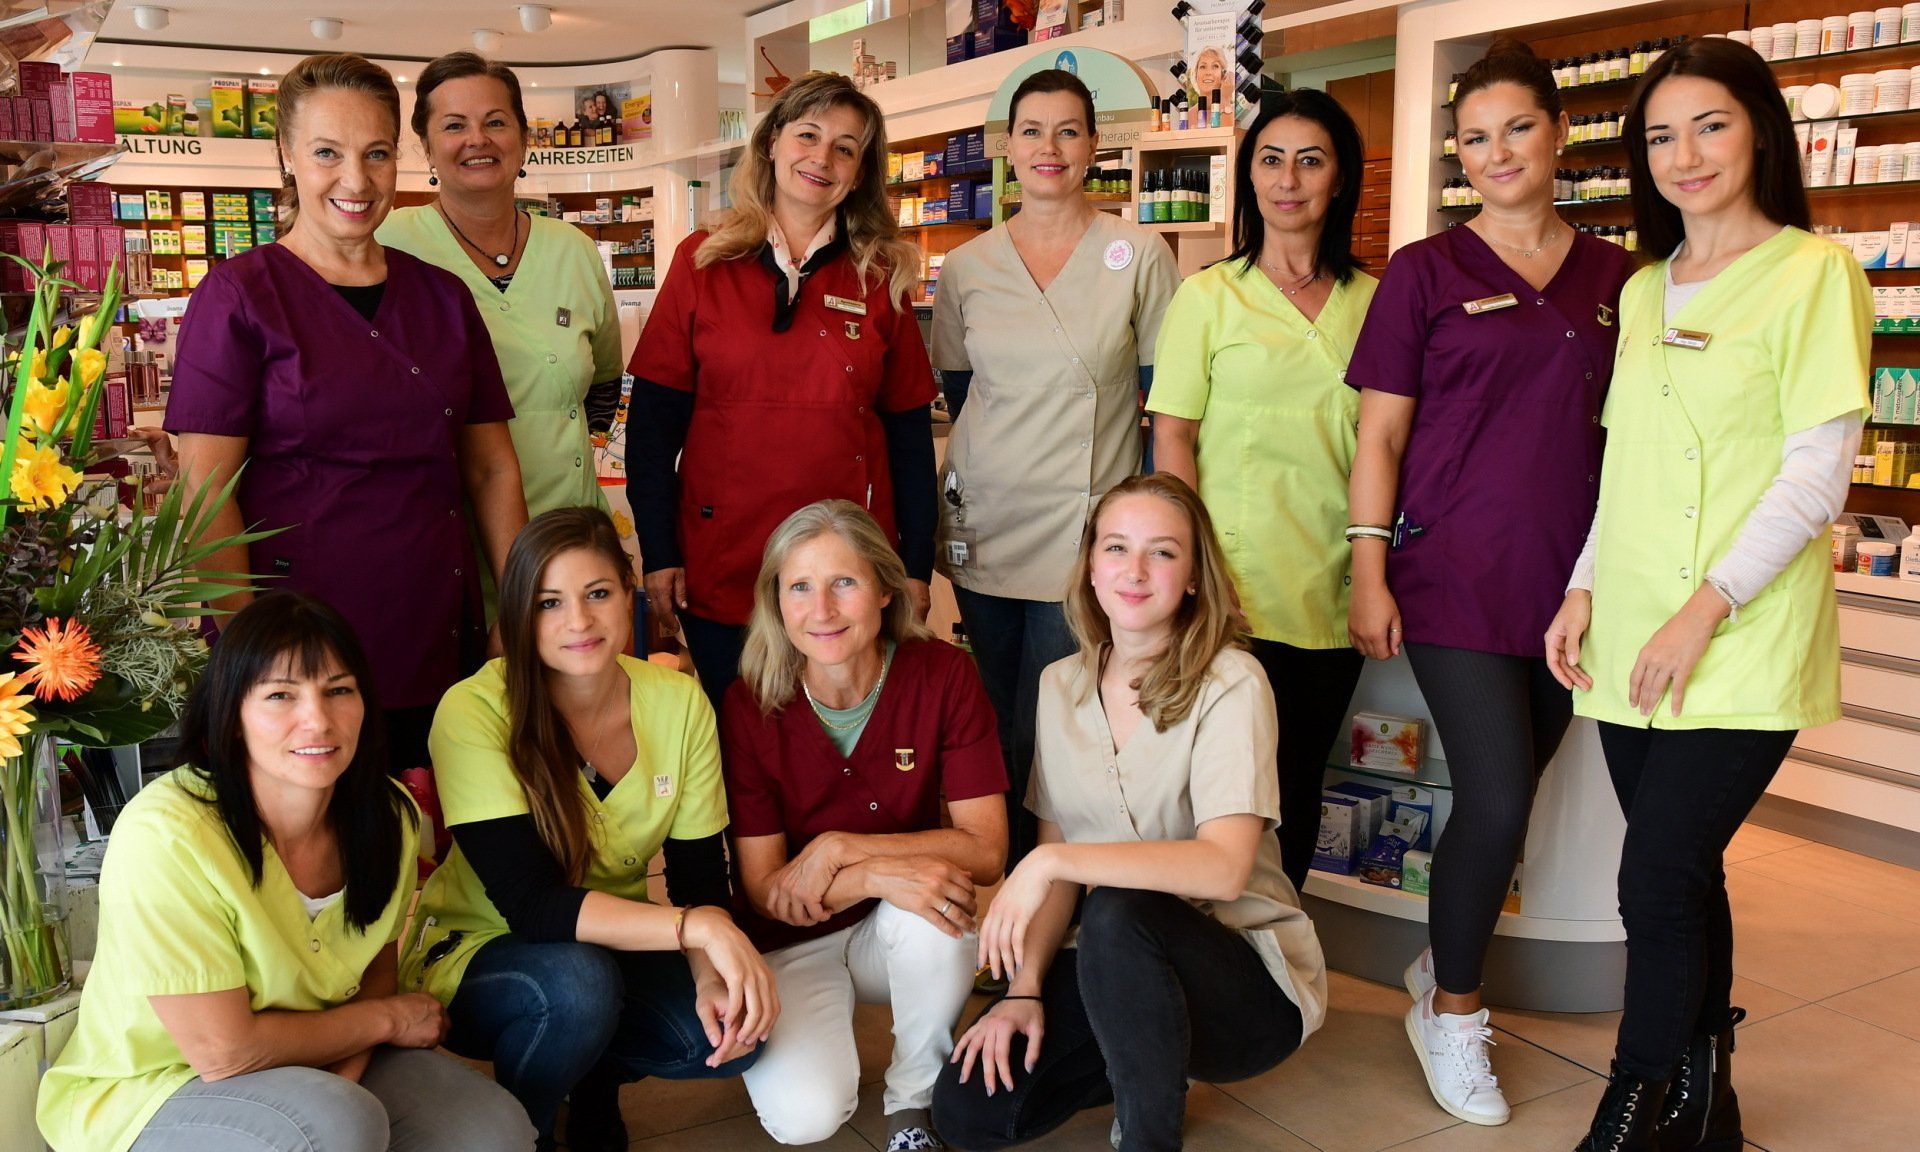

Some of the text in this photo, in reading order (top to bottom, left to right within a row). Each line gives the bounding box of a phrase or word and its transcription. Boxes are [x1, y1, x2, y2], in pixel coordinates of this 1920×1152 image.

[122, 135, 202, 155] ÄLTUNG
[995, 139, 1007, 151] Ga
[1100, 130, 1140, 143] herapie
[527, 147, 633, 165] AHRESZEITEN
